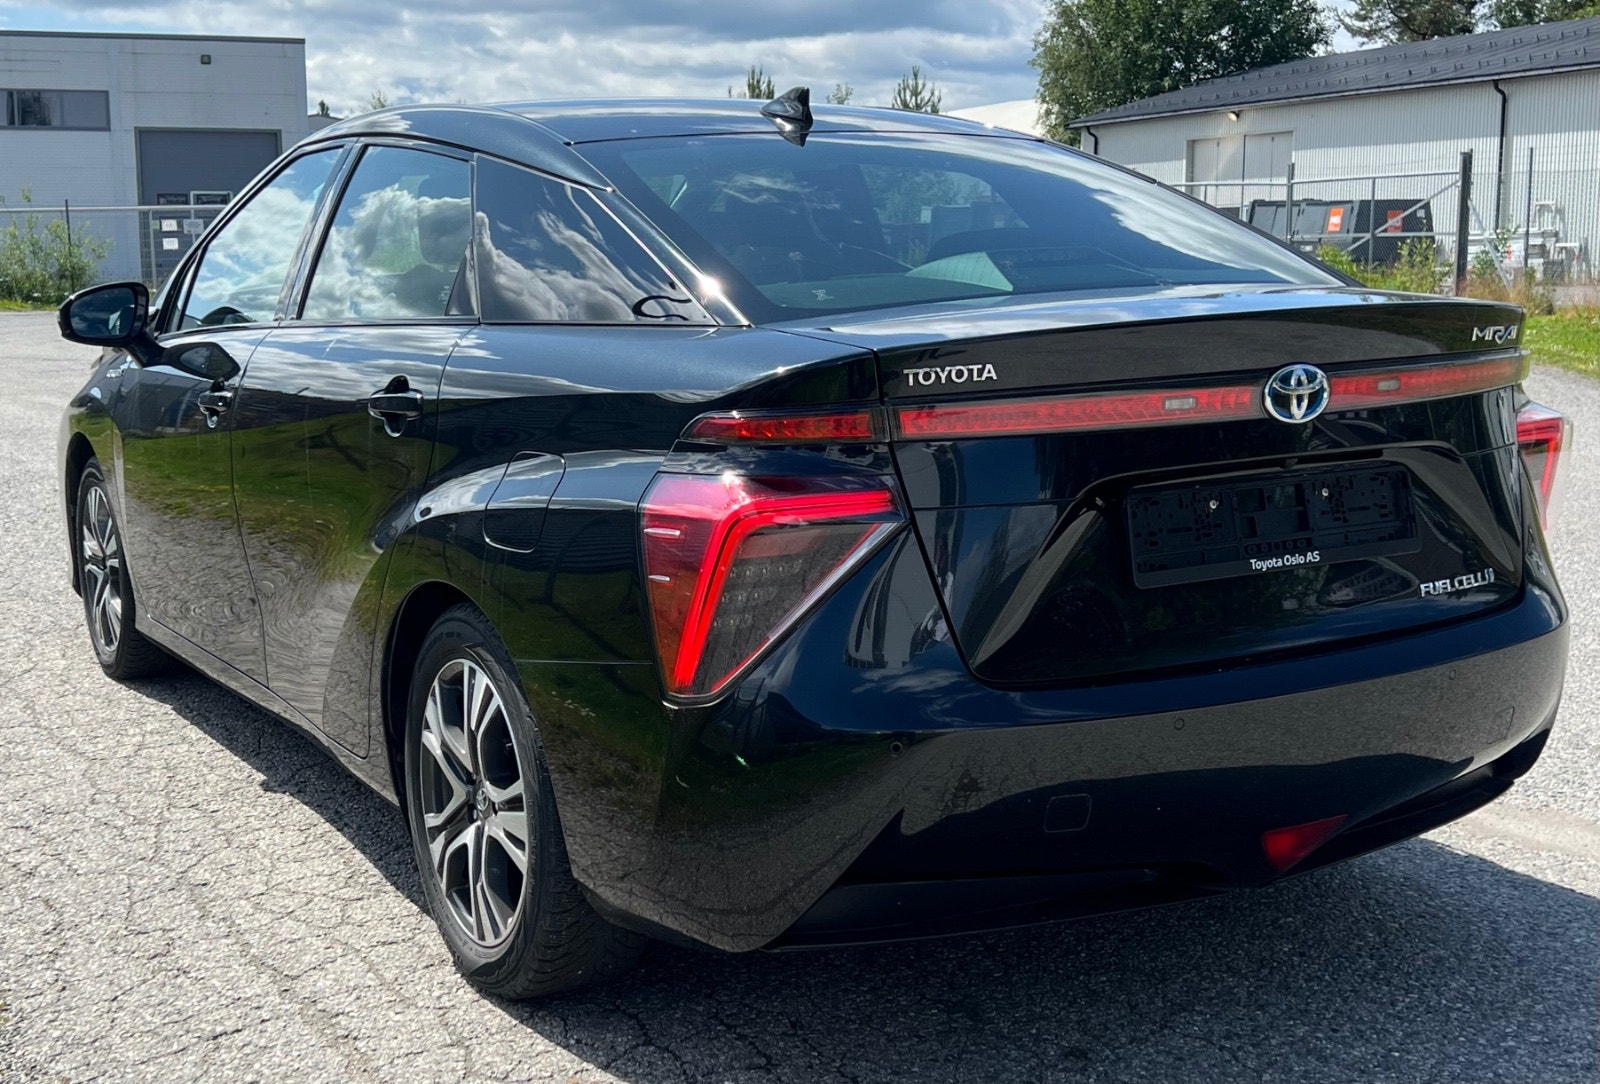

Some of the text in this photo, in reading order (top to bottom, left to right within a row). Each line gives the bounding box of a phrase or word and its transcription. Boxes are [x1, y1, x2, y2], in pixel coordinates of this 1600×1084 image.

[1471, 325, 1518, 344] MIRAI
[903, 363, 997, 386] TOYOTA
[1250, 551, 1320, 571] Toyota Oslo AS
[1420, 579, 1456, 597] FUEL
